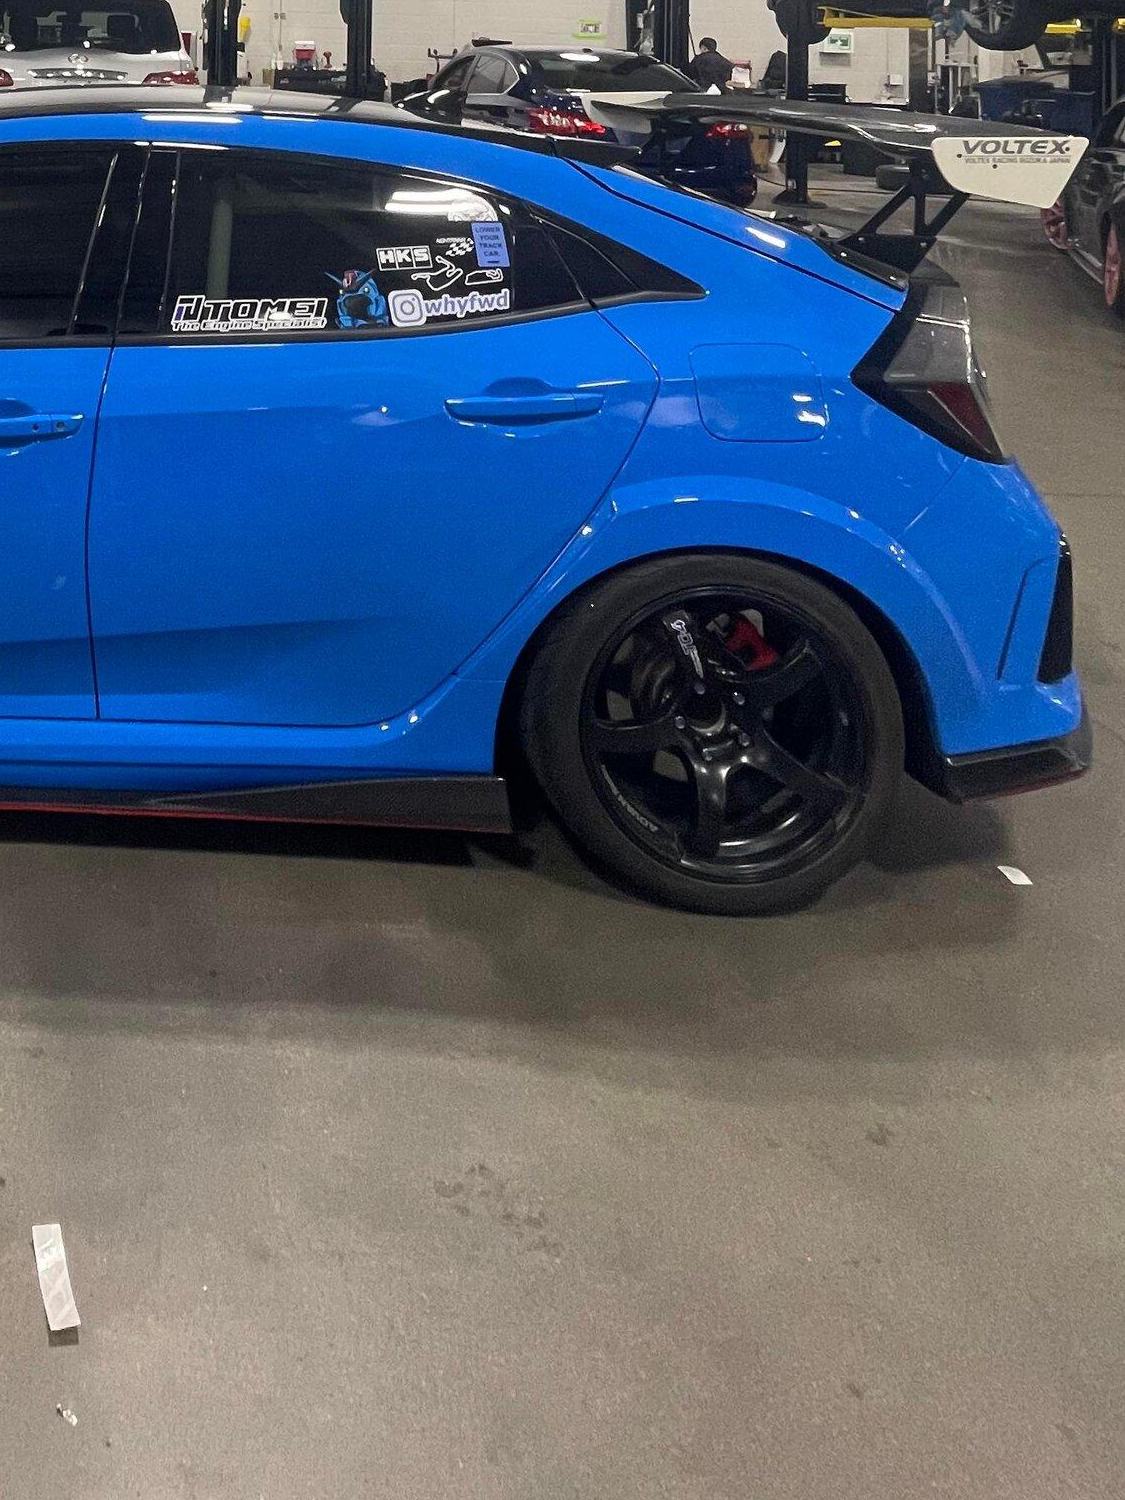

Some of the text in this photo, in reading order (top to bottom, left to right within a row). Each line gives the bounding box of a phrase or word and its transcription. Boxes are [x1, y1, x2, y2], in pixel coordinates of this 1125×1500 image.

[962, 139, 1070, 155] VOLTEX
[378, 248, 431, 265] HKS
[205, 298, 328, 321] TOMEI
[424, 289, 509, 317] whyfwd
[172, 318, 328, 332] The Engine Specialist
